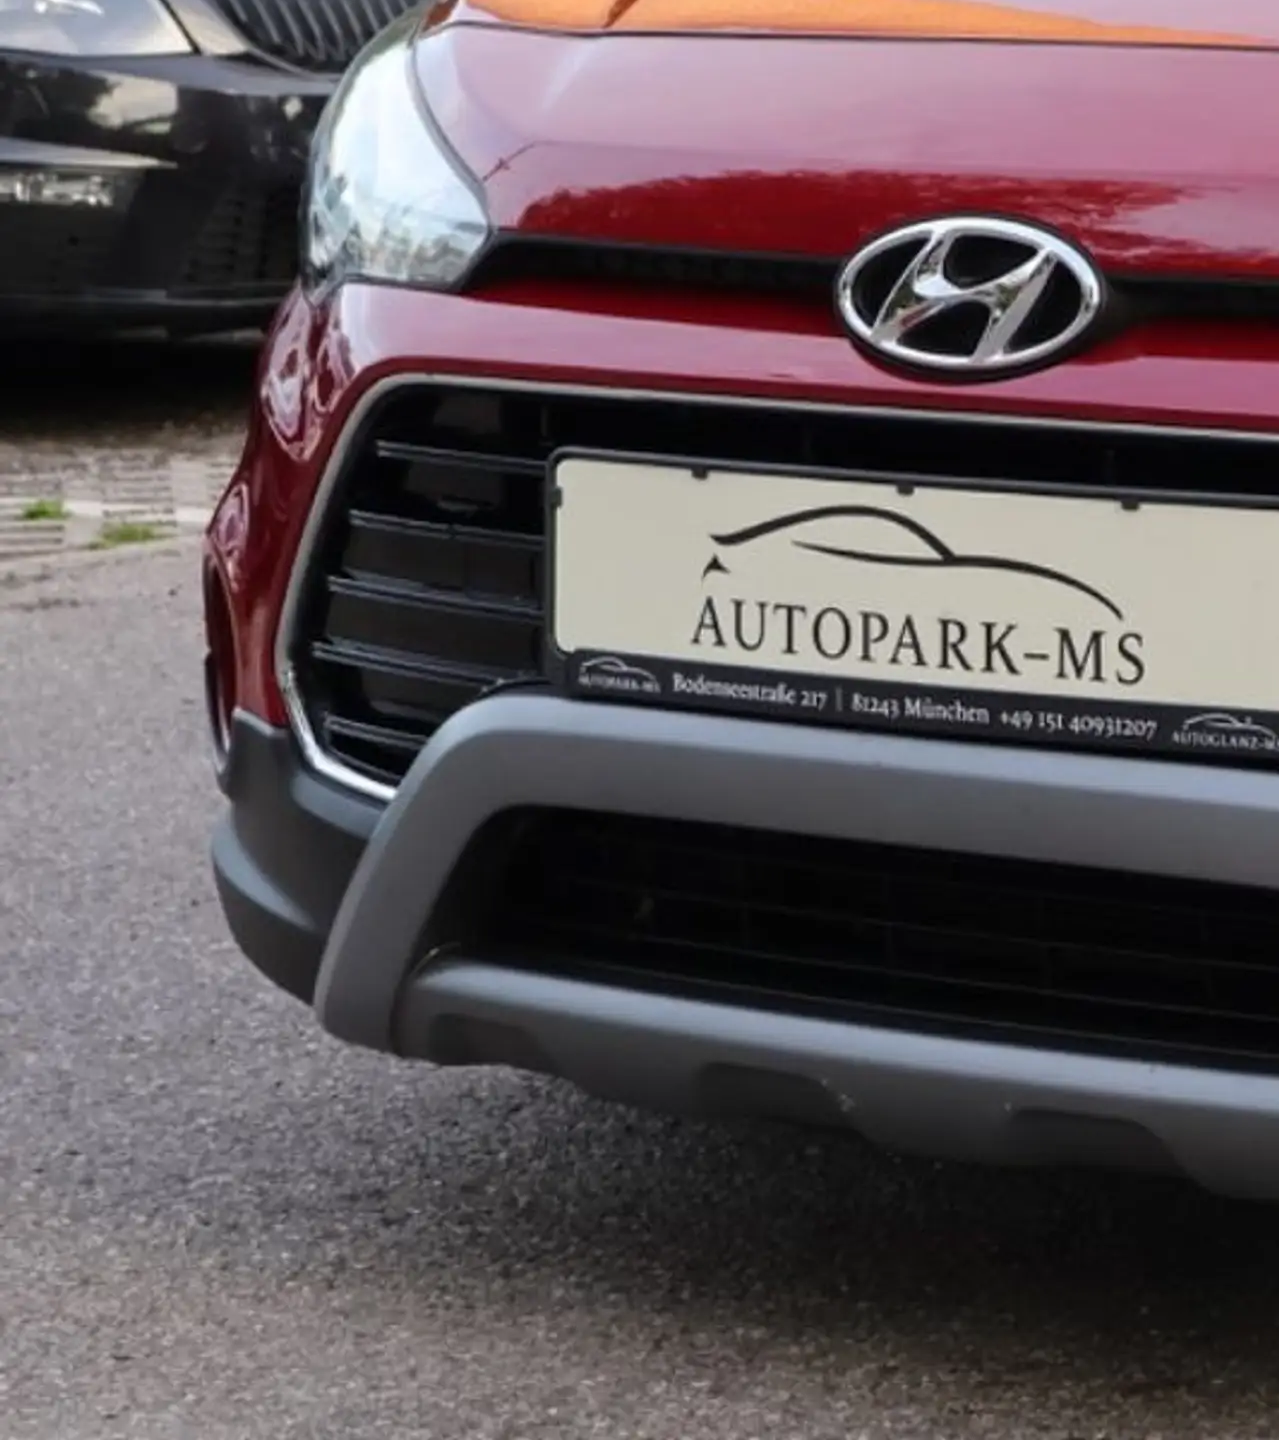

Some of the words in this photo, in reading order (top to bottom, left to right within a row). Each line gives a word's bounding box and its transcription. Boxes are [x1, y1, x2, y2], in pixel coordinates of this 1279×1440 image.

[690, 595, 1146, 687] AUTOPARK-MS
[671, 672, 797, 706] Bodenseestraße
[800, 690, 828, 711] 217
[851, 692, 900, 720] 81243
[904, 696, 990, 726] München
[1001, 710, 1034, 732] +49
[1038, 712, 1064, 733] 151
[1068, 715, 1158, 742] 40931207
